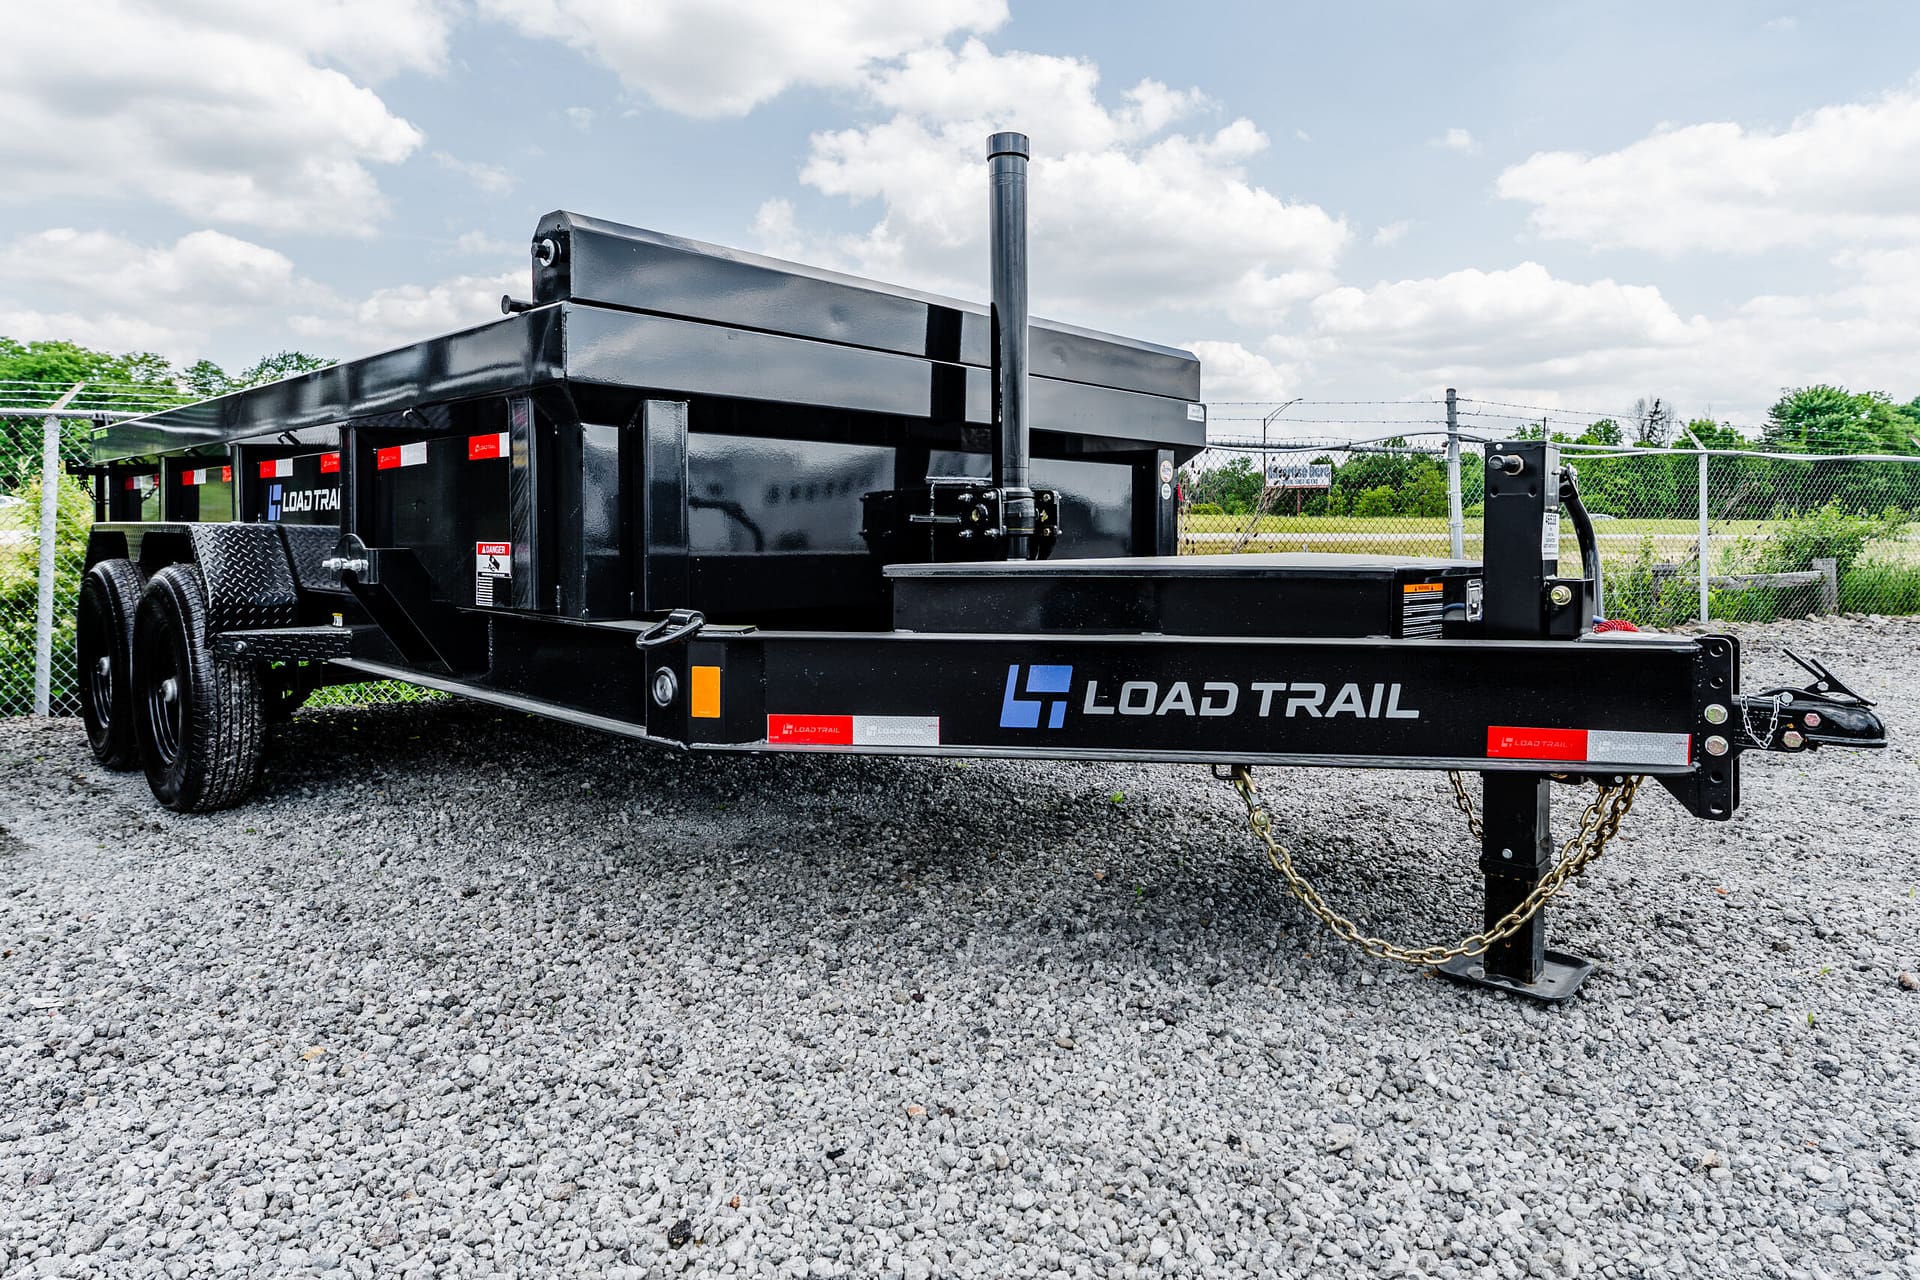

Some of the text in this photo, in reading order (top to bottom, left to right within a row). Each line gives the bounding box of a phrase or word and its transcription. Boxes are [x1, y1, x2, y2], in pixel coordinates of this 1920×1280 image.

[282, 488, 340, 512] LOAD TRAI
[1083, 680, 1420, 719] LOAD TRAIL
[1514, 739, 1568, 748] LOAD TRAIL
